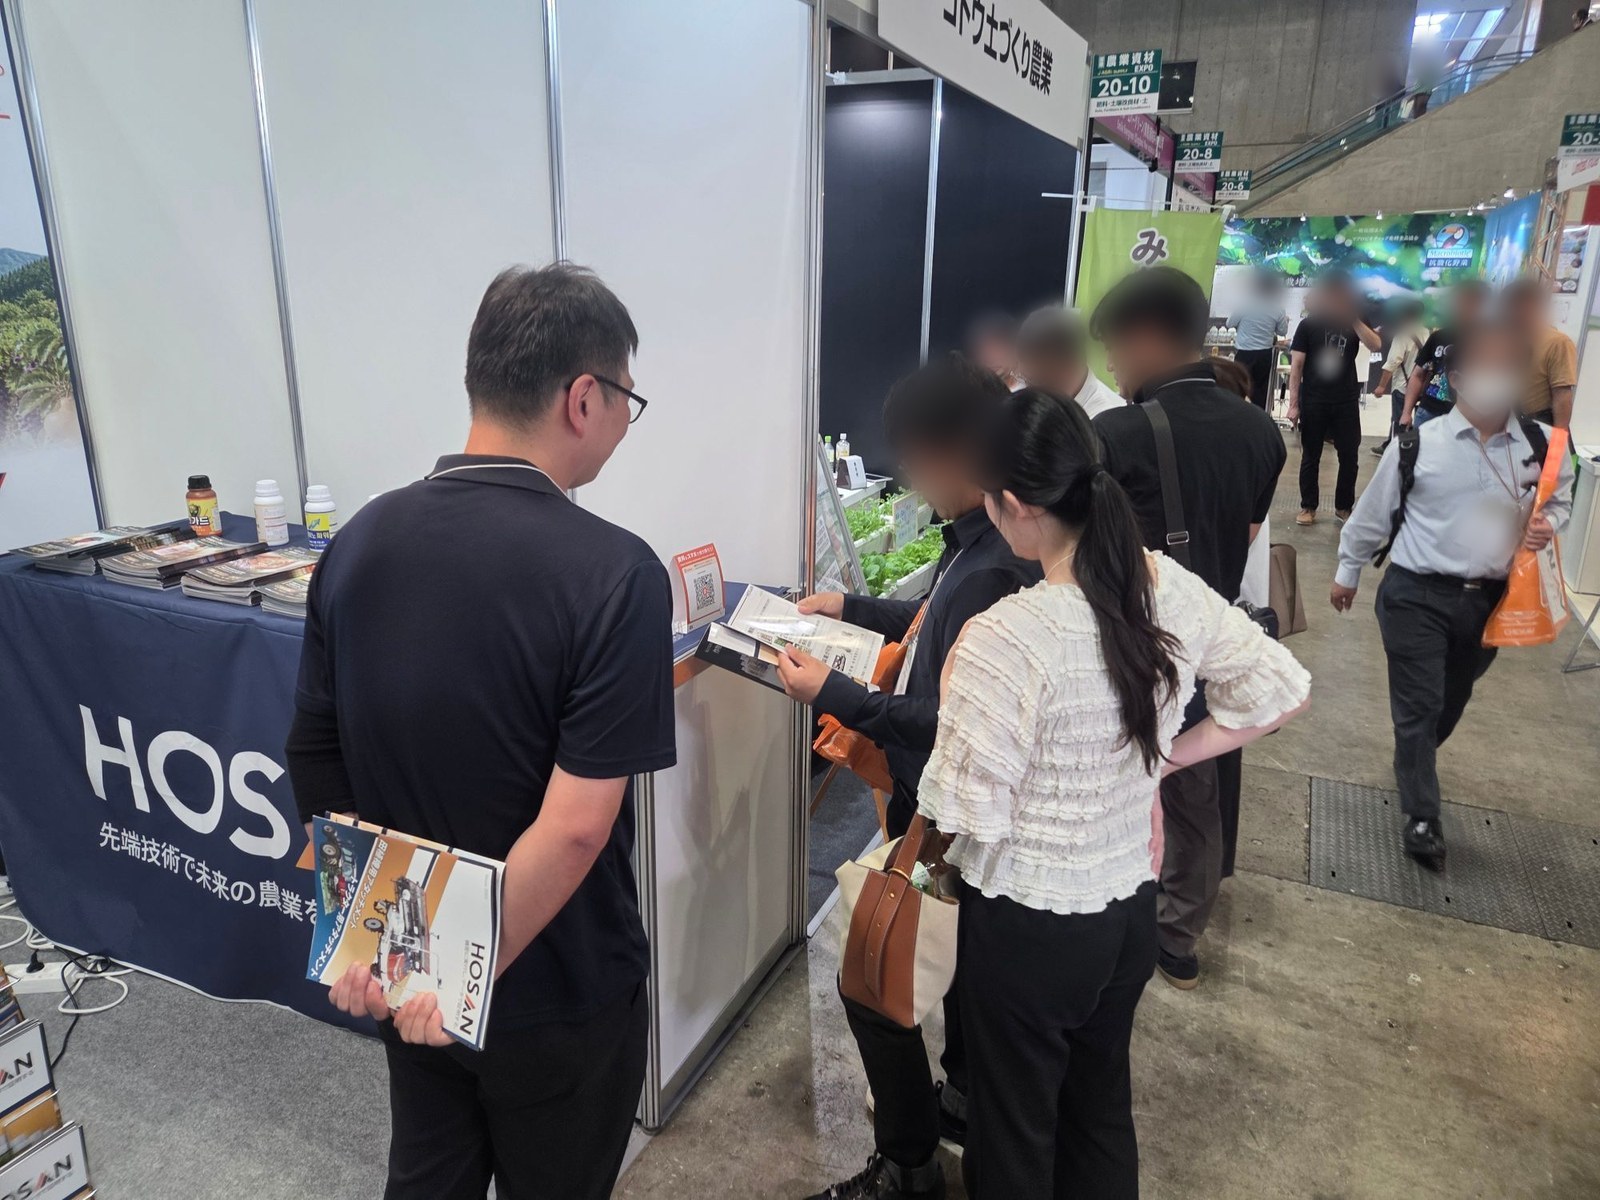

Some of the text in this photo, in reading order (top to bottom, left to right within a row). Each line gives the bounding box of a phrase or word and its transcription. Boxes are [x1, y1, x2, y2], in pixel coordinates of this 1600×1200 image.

[1134, 64, 1154, 73] EXPO
[1098, 75, 1151, 97] 20-10
[1182, 147, 1213, 160] 20-8
[1221, 181, 1244, 191] 20-6
[1131, 229, 1168, 266] み
[79, 703, 291, 860] HOS
[459, 942, 485, 1036] HOSAN
